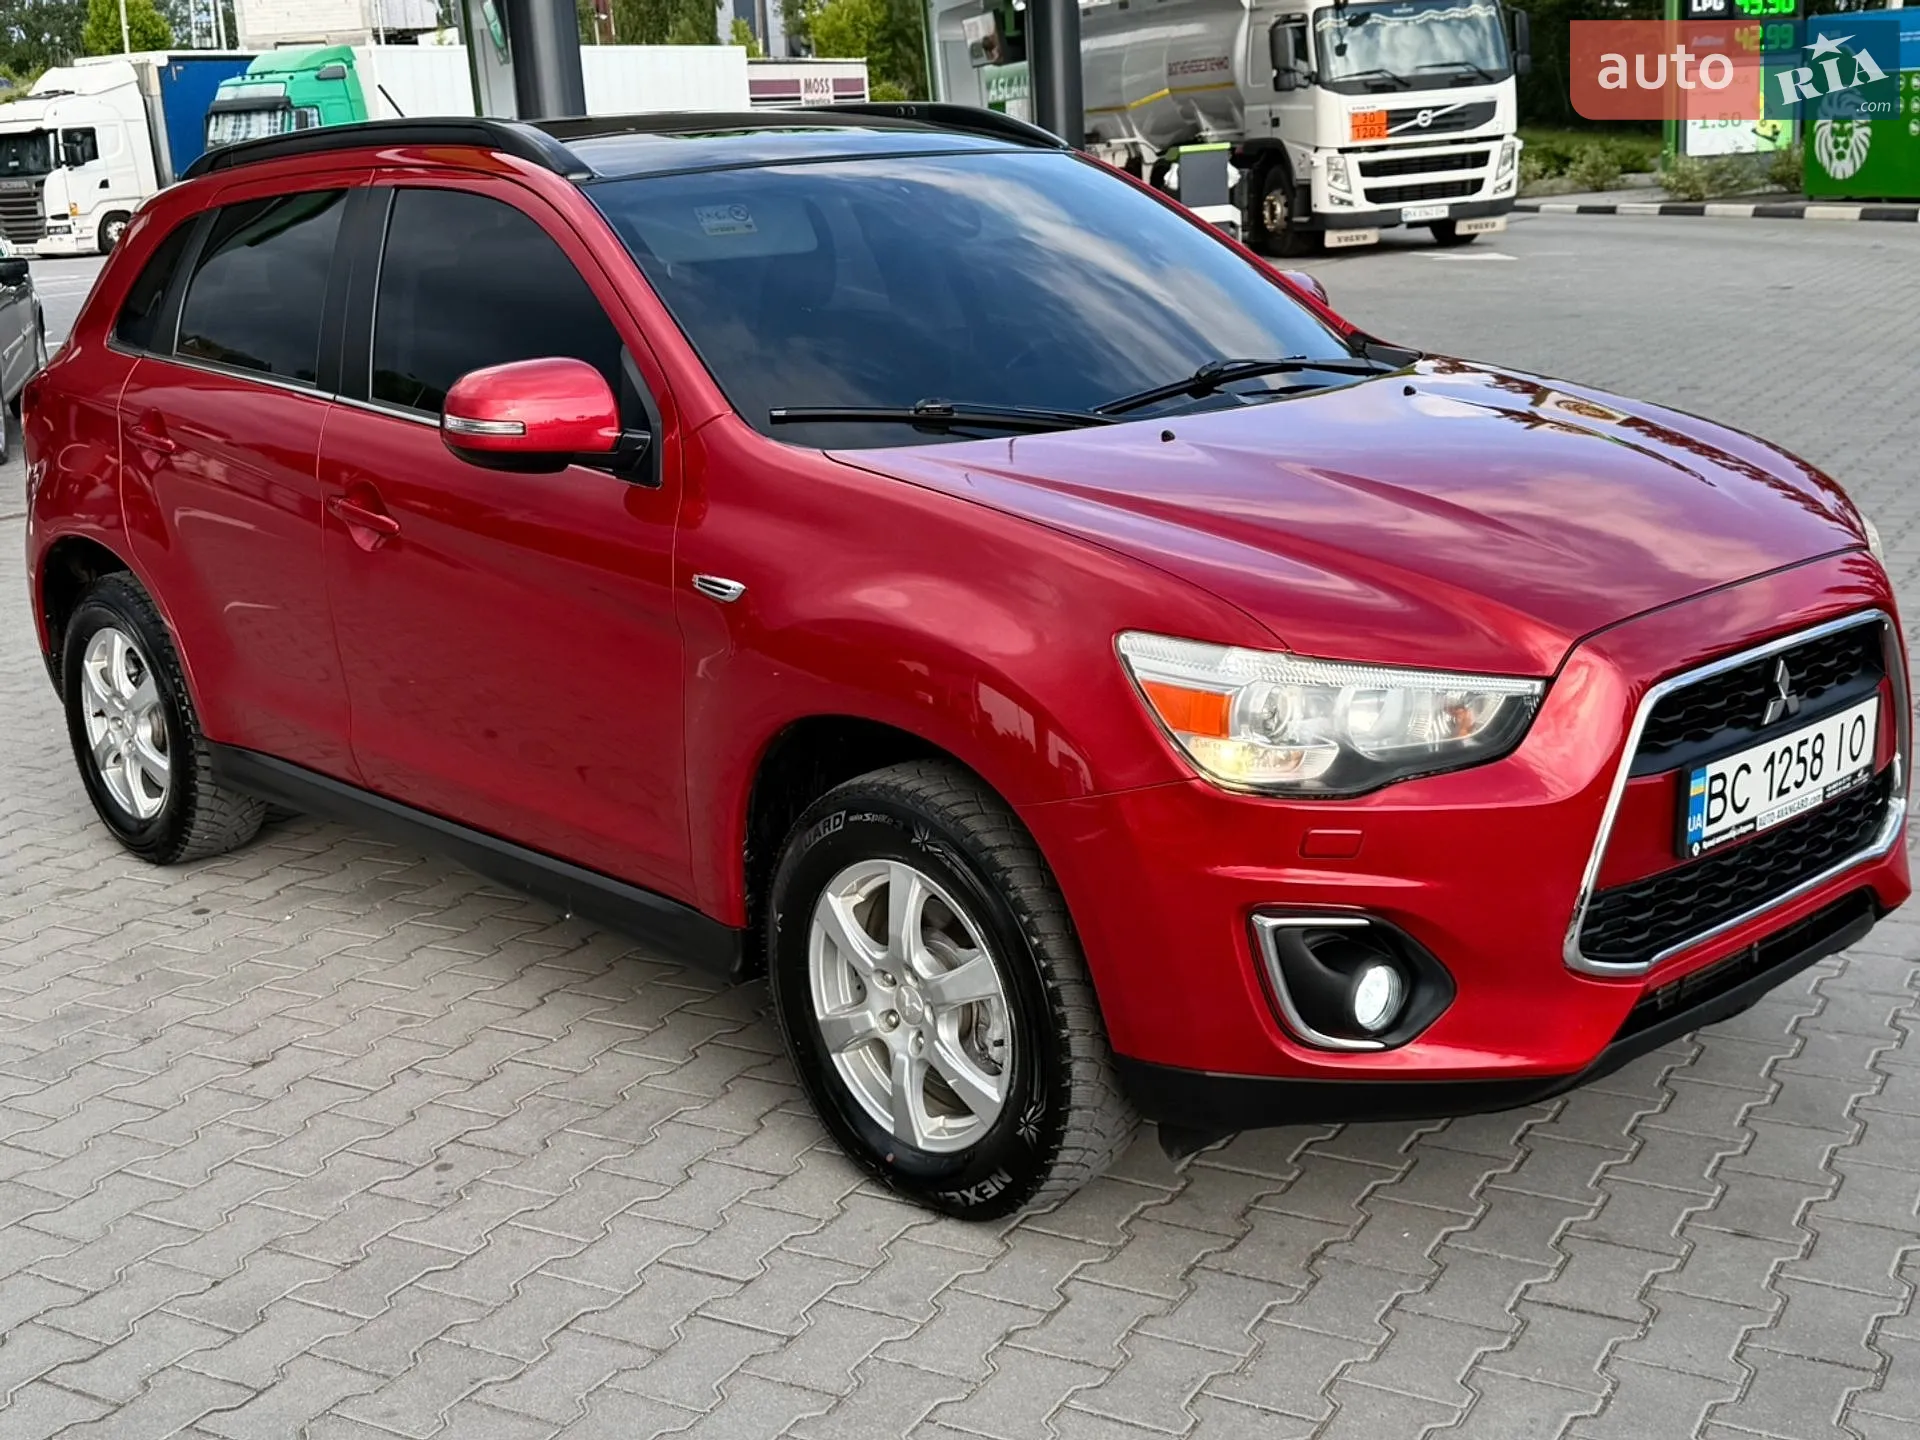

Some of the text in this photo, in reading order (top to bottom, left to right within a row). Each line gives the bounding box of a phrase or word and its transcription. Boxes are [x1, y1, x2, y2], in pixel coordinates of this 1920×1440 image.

[803, 78, 830, 94] MOSS
[1362, 111, 1376, 124] 30
[1356, 126, 1384, 139] 1202
[1467, 220, 1497, 231] VOLVO
[1336, 234, 1368, 244] VOLVO
[1706, 763, 1751, 827] BC
[1763, 731, 1825, 802] 1258
[1837, 714, 1866, 772] IO
[1688, 814, 1703, 833] UA
